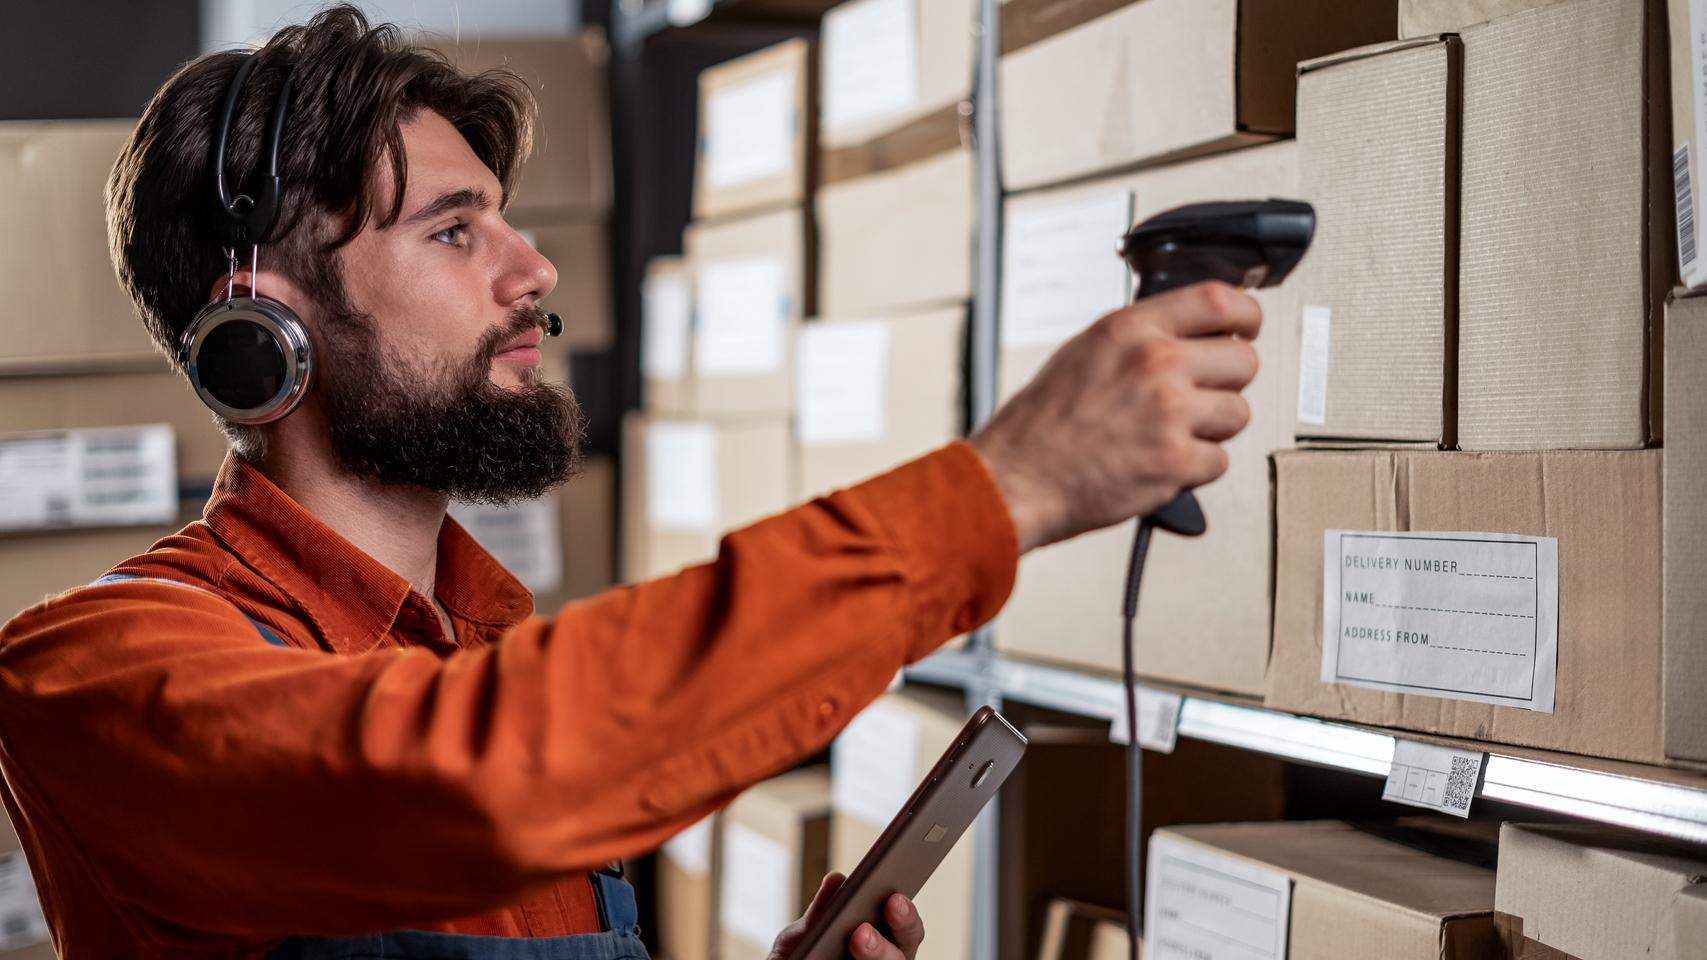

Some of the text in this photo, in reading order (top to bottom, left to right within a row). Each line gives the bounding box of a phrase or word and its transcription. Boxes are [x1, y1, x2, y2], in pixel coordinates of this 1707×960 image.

[1345, 555, 1458, 573] DELIVERY NUMBER
[1345, 591, 1375, 605] NAME
[1344, 627, 1430, 645] ADDRESS FROM
